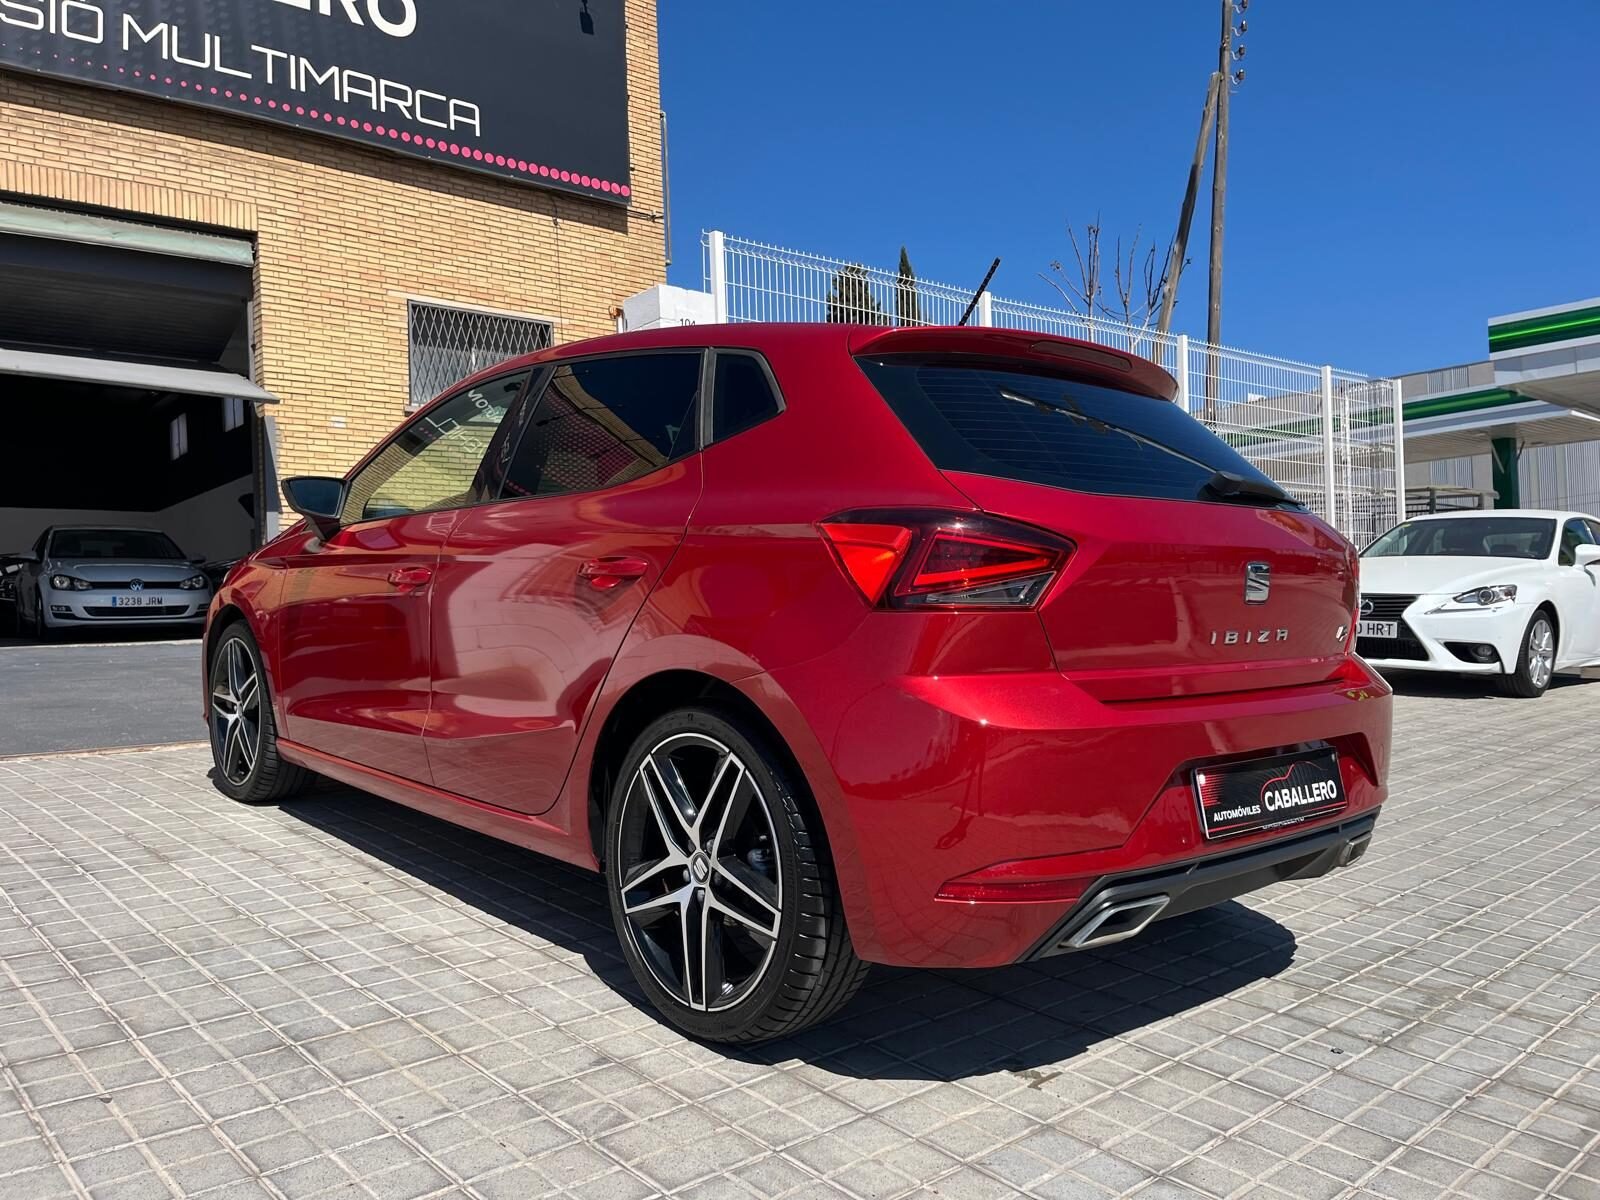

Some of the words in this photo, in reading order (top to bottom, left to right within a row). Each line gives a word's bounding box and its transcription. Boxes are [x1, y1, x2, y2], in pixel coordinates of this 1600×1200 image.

[122, 13, 481, 137] MULTIMARCA
[118, 596, 143, 606] 3238
[1210, 628, 1289, 645] IBIZA
[1367, 623, 1394, 636] HRT
[1213, 806, 1261, 822] AUTOMÓVILES
[1264, 780, 1337, 812] CABALLERO
